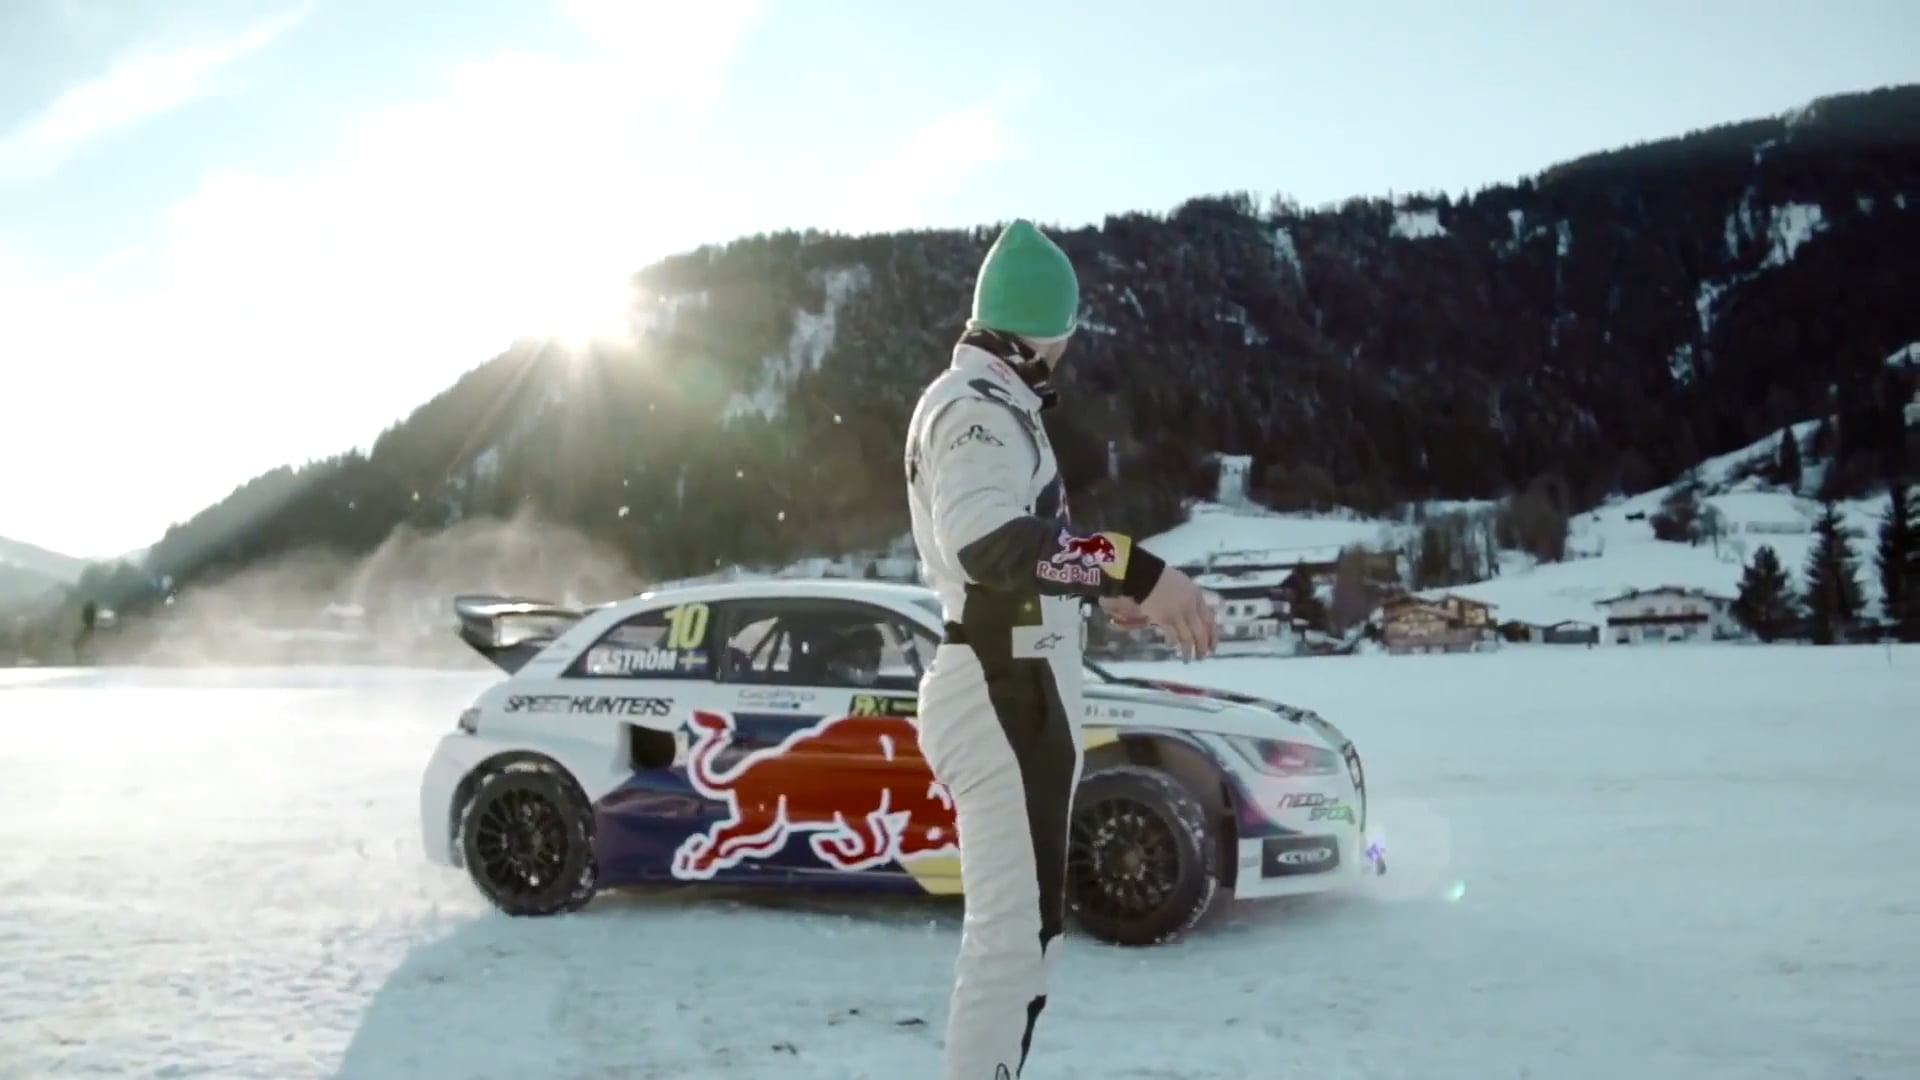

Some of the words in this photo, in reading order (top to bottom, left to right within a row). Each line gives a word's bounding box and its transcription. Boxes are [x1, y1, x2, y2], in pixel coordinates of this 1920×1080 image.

[1036, 560, 1070, 584] Red
[1070, 566, 1101, 586] Bull
[664, 603, 709, 650] 10
